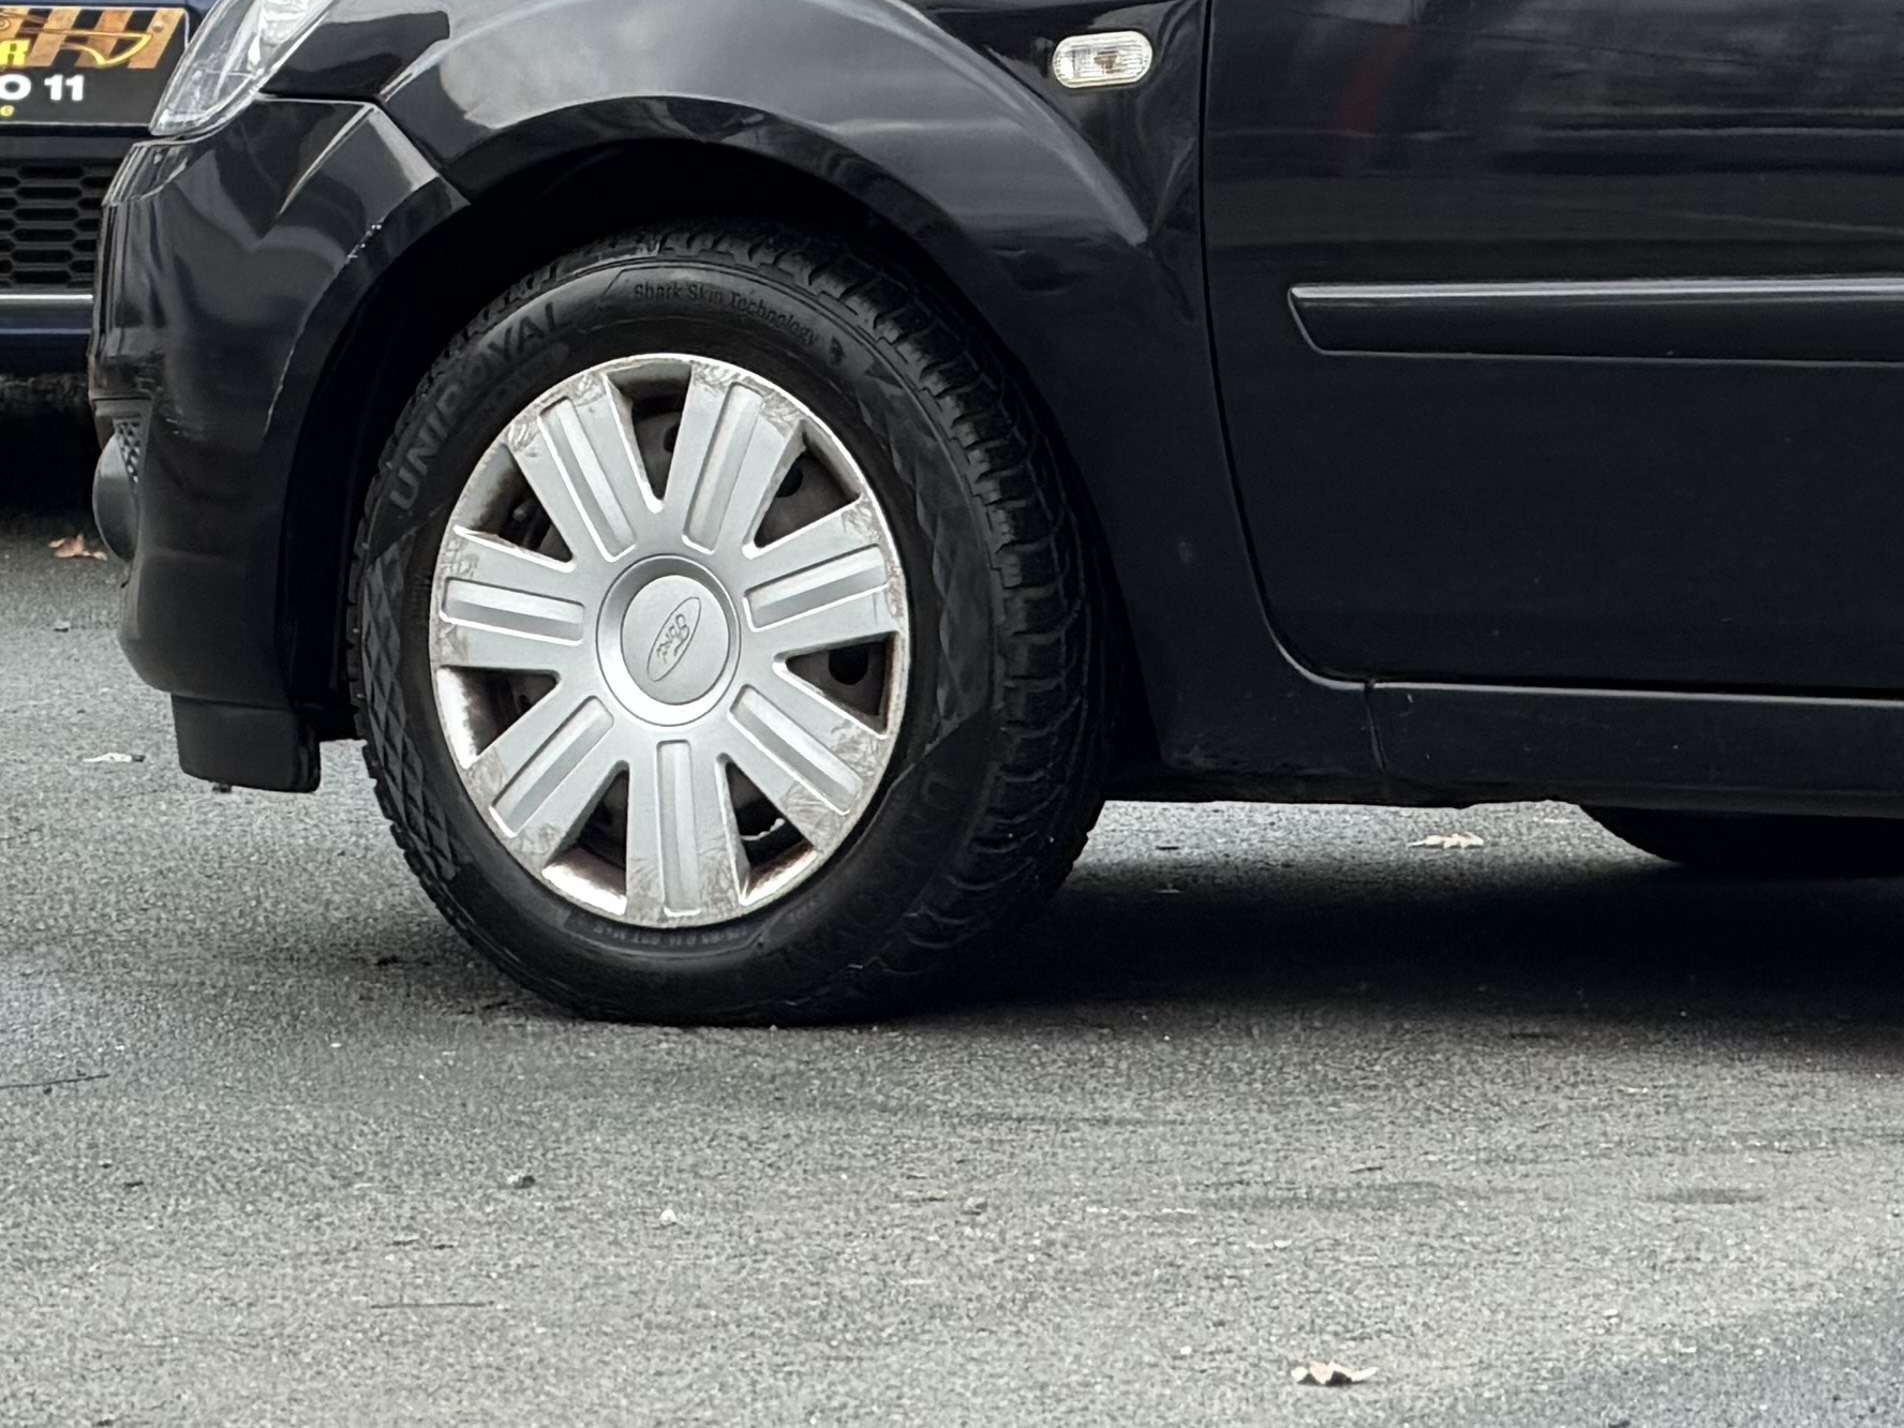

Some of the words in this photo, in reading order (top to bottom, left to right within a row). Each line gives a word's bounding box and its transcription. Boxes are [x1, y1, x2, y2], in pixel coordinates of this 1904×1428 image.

[44, 74, 85, 102] 11
[634, 283, 682, 302] Shark
[687, 282, 724, 305] Skin
[729, 292, 817, 344] Technology
